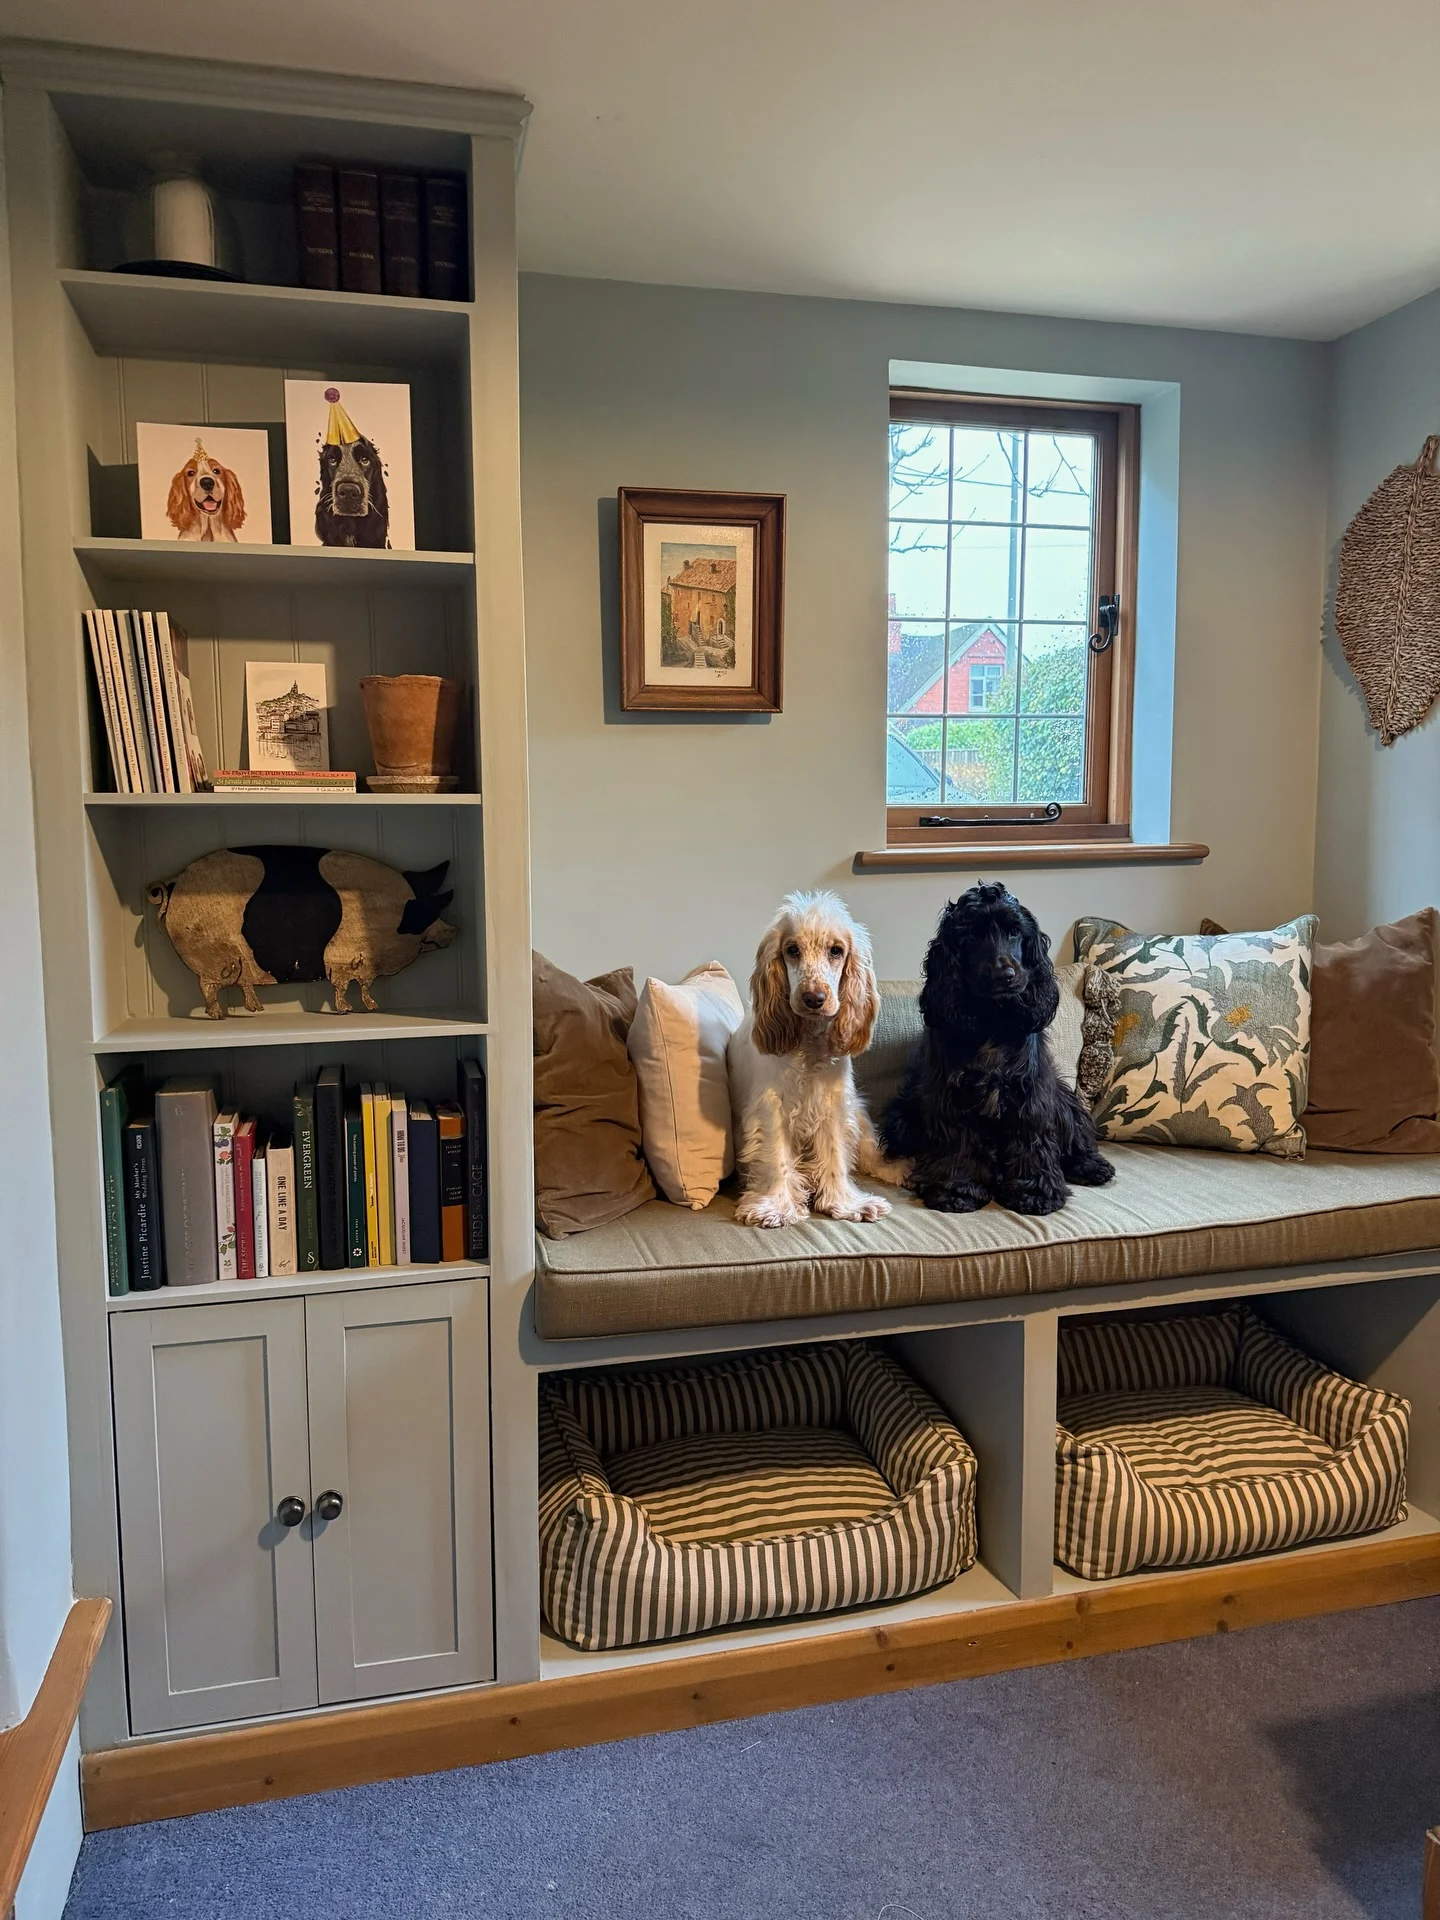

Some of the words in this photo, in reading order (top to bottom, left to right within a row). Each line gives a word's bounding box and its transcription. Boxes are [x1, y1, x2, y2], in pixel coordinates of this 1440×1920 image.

[302, 1130, 312, 1189] EVERGREEN
[135, 1190, 142, 1199] My
[277, 1176, 287, 1188] ONE
[472, 1164, 483, 1197] CAGE
[278, 1192, 287, 1207] LINE
[138, 1204, 148, 1242] Picardie
[278, 1217, 287, 1230] DAY
[472, 1214, 482, 1250] BIRDS
[141, 1246, 152, 1280] Justine
